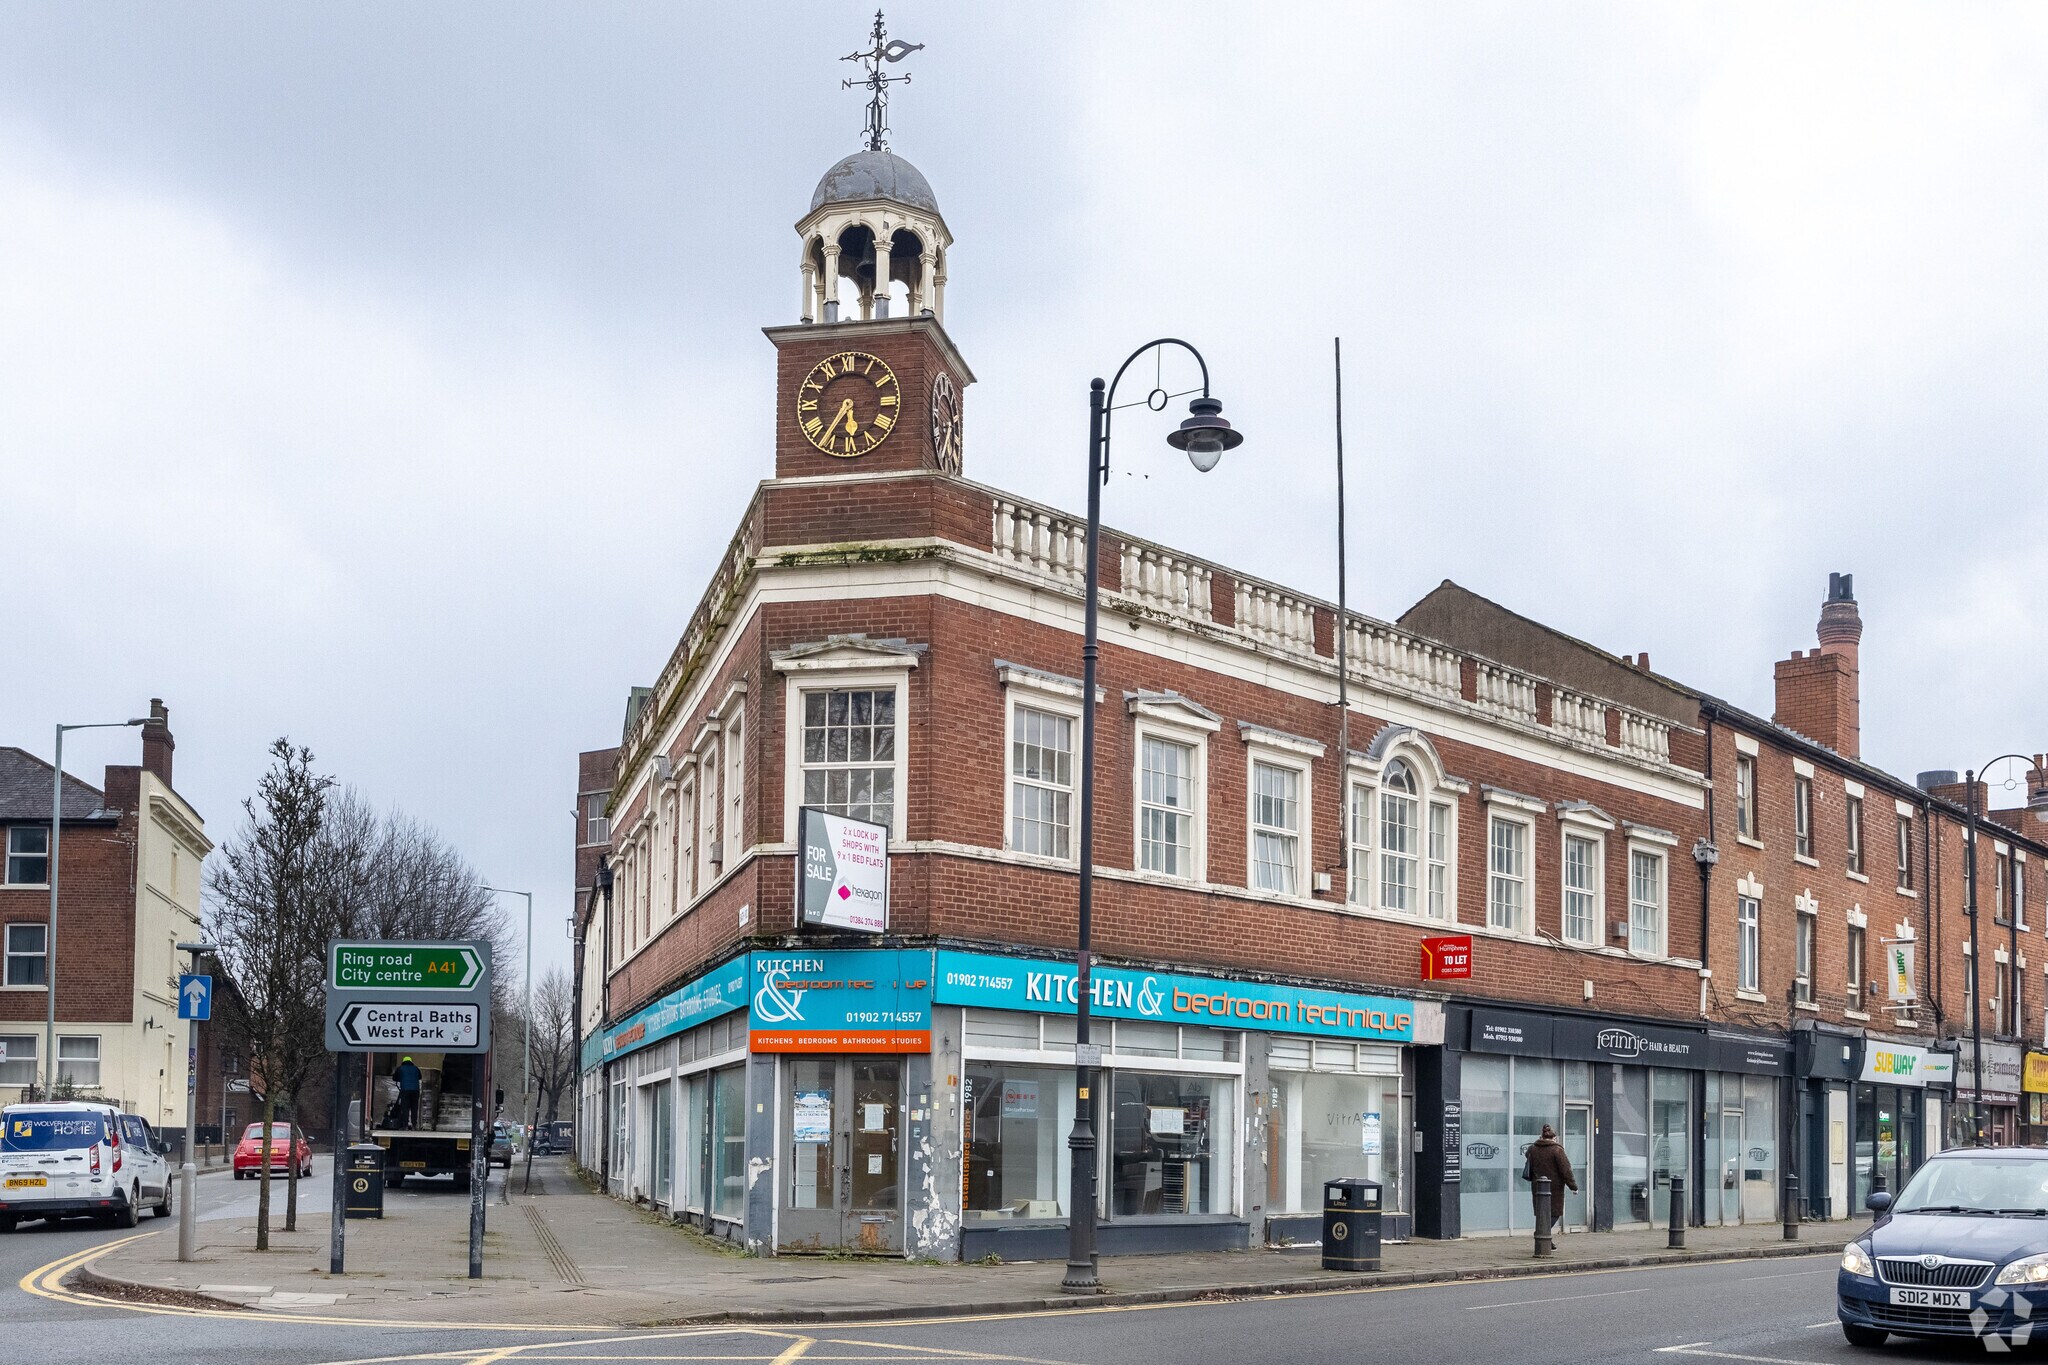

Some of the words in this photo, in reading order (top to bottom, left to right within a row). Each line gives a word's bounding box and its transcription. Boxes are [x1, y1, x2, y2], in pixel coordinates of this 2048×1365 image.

[841, 78, 851, 90] N
[904, 73, 911, 84] S
[841, 355, 854, 373] XII
[807, 379, 823, 393] X
[880, 396, 896, 406] III
[864, 431, 876, 446] V
[843, 826, 847, 834] 2
[853, 829, 869, 840] LOCK
[870, 833, 878, 842] UP
[842, 839, 863, 851] SHOPS
[864, 843, 879, 854] WITH
[807, 845, 826, 863] FOR
[837, 851, 841, 859] 9
[852, 854, 865, 865] BED
[866, 857, 884, 868] FLATS
[806, 863, 832, 882] SALE
[852, 884, 883, 901] hexagon
[849, 915, 863, 925] 01384
[864, 918, 874, 926] 374
[342, 952, 374, 968] Ring
[380, 953, 412, 965] road
[756, 959, 825, 973] KITCHEN
[1444, 955, 1453, 965] TO
[1455, 955, 1468, 965] LET
[341, 968, 371, 983] City
[376, 969, 422, 981] centre
[1896, 949, 1907, 995] SUBWAY
[775, 979, 844, 989] bedroom
[754, 969, 808, 1023] &
[947, 972, 977, 987] 01902
[978, 975, 1013, 990] 714557
[1026, 971, 1133, 1008] KITCHEN
[1137, 976, 1165, 1016] &
[1172, 986, 1290, 1022] bedroom
[1297, 999, 1411, 1034] technique
[367, 1009, 423, 1023] Central
[429, 1010, 472, 1023] Baths
[846, 1012, 879, 1023] 01902
[881, 1012, 922, 1023] 714557
[367, 1025, 405, 1038] West
[411, 1026, 444, 1039] Park
[757, 1037, 793, 1045] KITCHENS
[798, 1037, 838, 1045] BEDROOMS
[842, 1037, 887, 1045] BATHROOMS
[891, 1037, 922, 1045] STUDIES
[1649, 1041, 1663, 1052] HAIR
[1663, 1043, 1668, 1052] &
[1669, 1043, 1690, 1054] BEAUTY
[1873, 1051, 1916, 1076] SUBWAY
[964, 1078, 973, 1103] 1982
[1327, 1113, 1361, 1125] VitrA
[1879, 1111, 1889, 1119] Open
[54, 1126, 97, 1135] HOMES
[962, 1142, 971, 1209] Established
[9, 1179, 29, 1187] BN69
[1899, 1291, 1929, 1305] SD12
[1933, 1293, 1961, 1306] MDX
